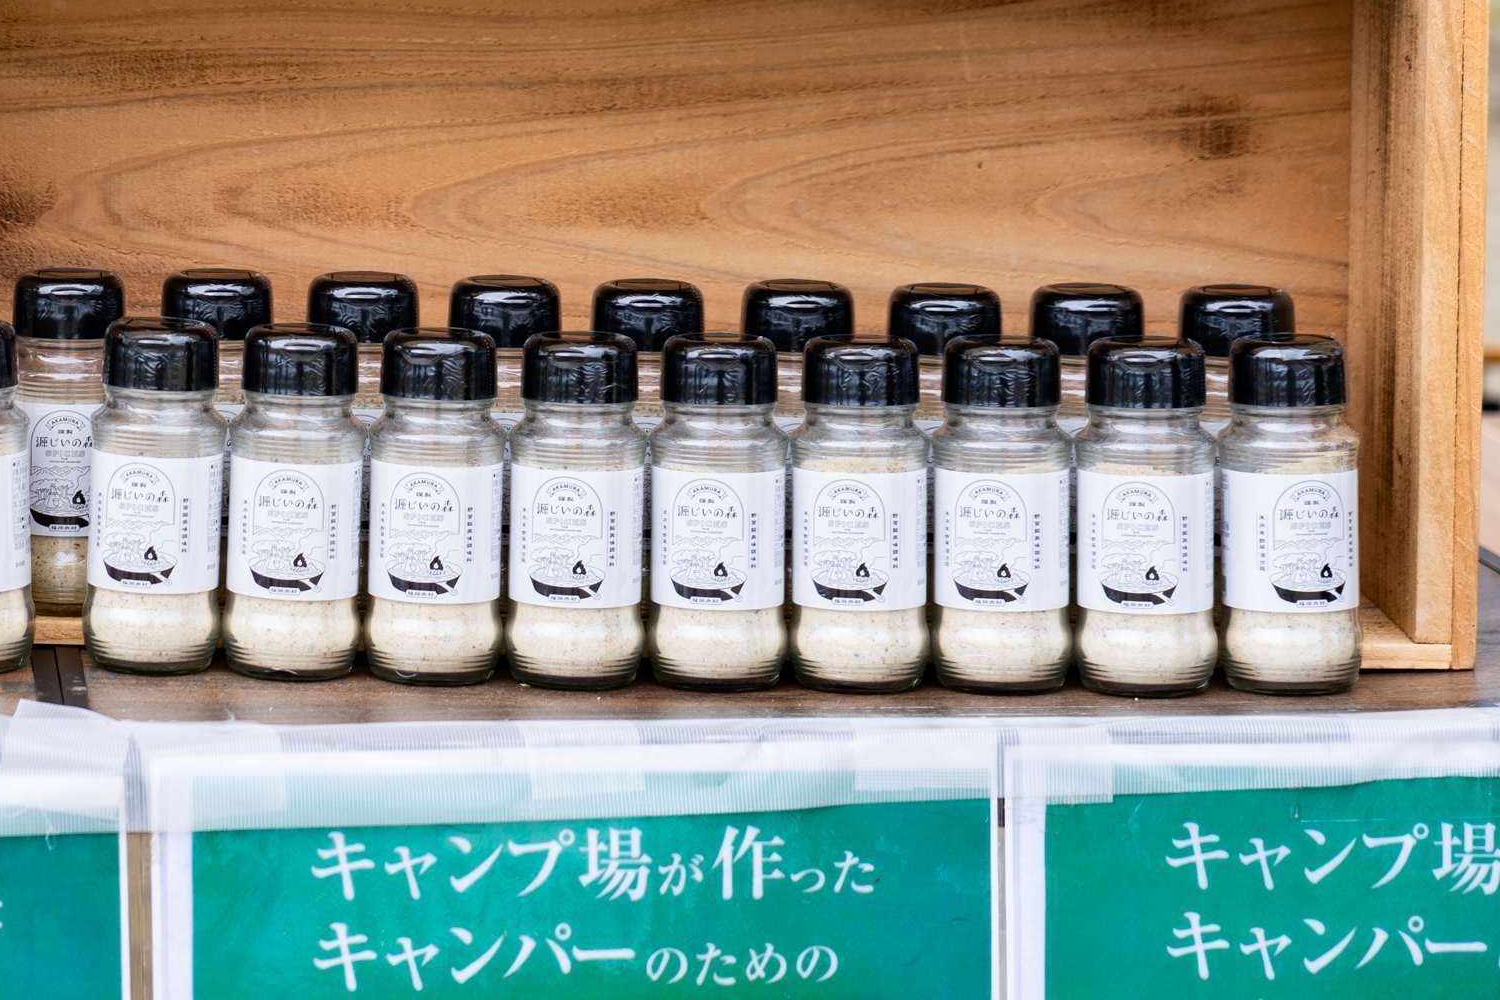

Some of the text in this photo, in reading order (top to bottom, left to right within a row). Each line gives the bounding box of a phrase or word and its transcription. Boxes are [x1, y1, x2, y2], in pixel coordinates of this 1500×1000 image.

[36, 436, 92, 448] 源じいの森
[111, 487, 169, 502] 源じいの森
[259, 494, 319, 509] 源じいの森
[395, 497, 454, 512] 源じいの森
[537, 502, 597, 516] 源じいの森
[678, 504, 738, 518] 源じいの森
[818, 504, 880, 519] 源じいの森
[960, 504, 1021, 519] 源じいの森
[1107, 507, 1169, 522] 源じいの森
[1280, 505, 1340, 520] 源じいの森
[311, 825, 875, 902] キャンプ場が作った
[1165, 822, 1500, 895] キャンプ場
[1166, 911, 1500, 980] キャンパー
[312, 922, 839, 992] キャンパーのための
